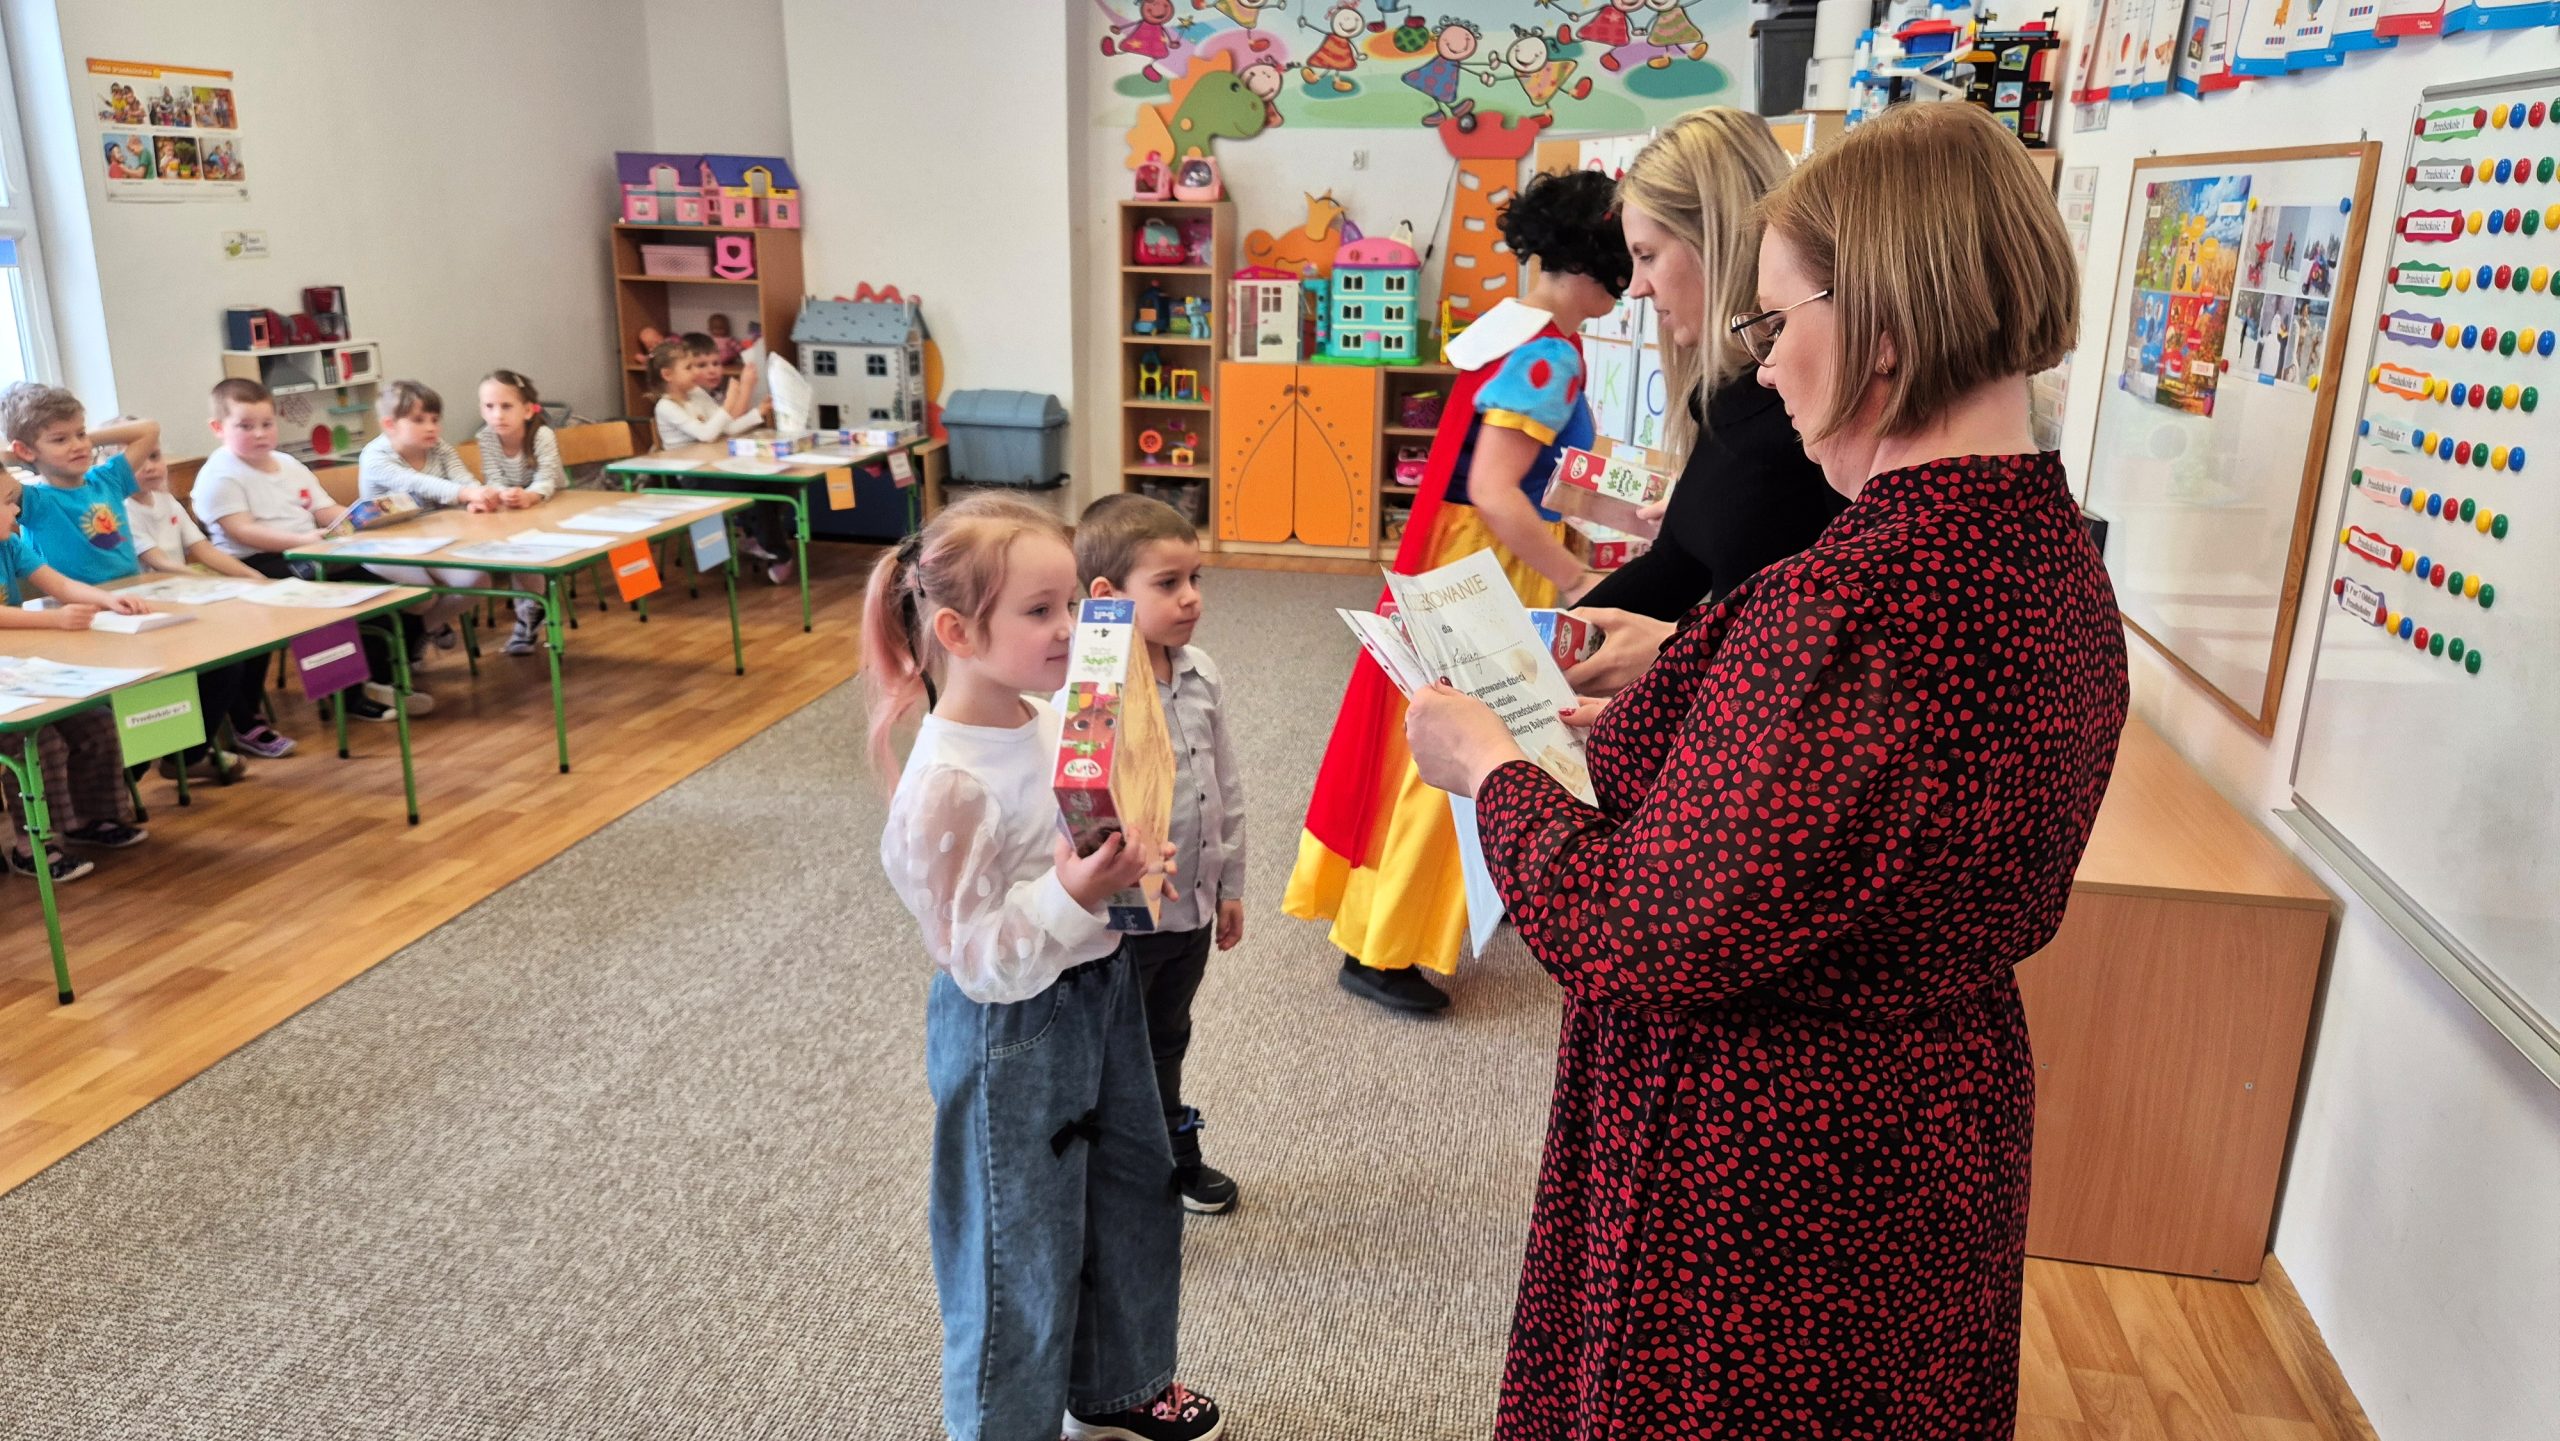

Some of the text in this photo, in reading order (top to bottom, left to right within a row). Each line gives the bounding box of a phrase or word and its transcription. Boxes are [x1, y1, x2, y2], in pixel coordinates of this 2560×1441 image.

[1441, 624, 1453, 634] dla
[1559, 624, 1571, 656] Bing
[1506, 671, 1527, 686] dzieci
[1495, 693, 1518, 708] udziału
